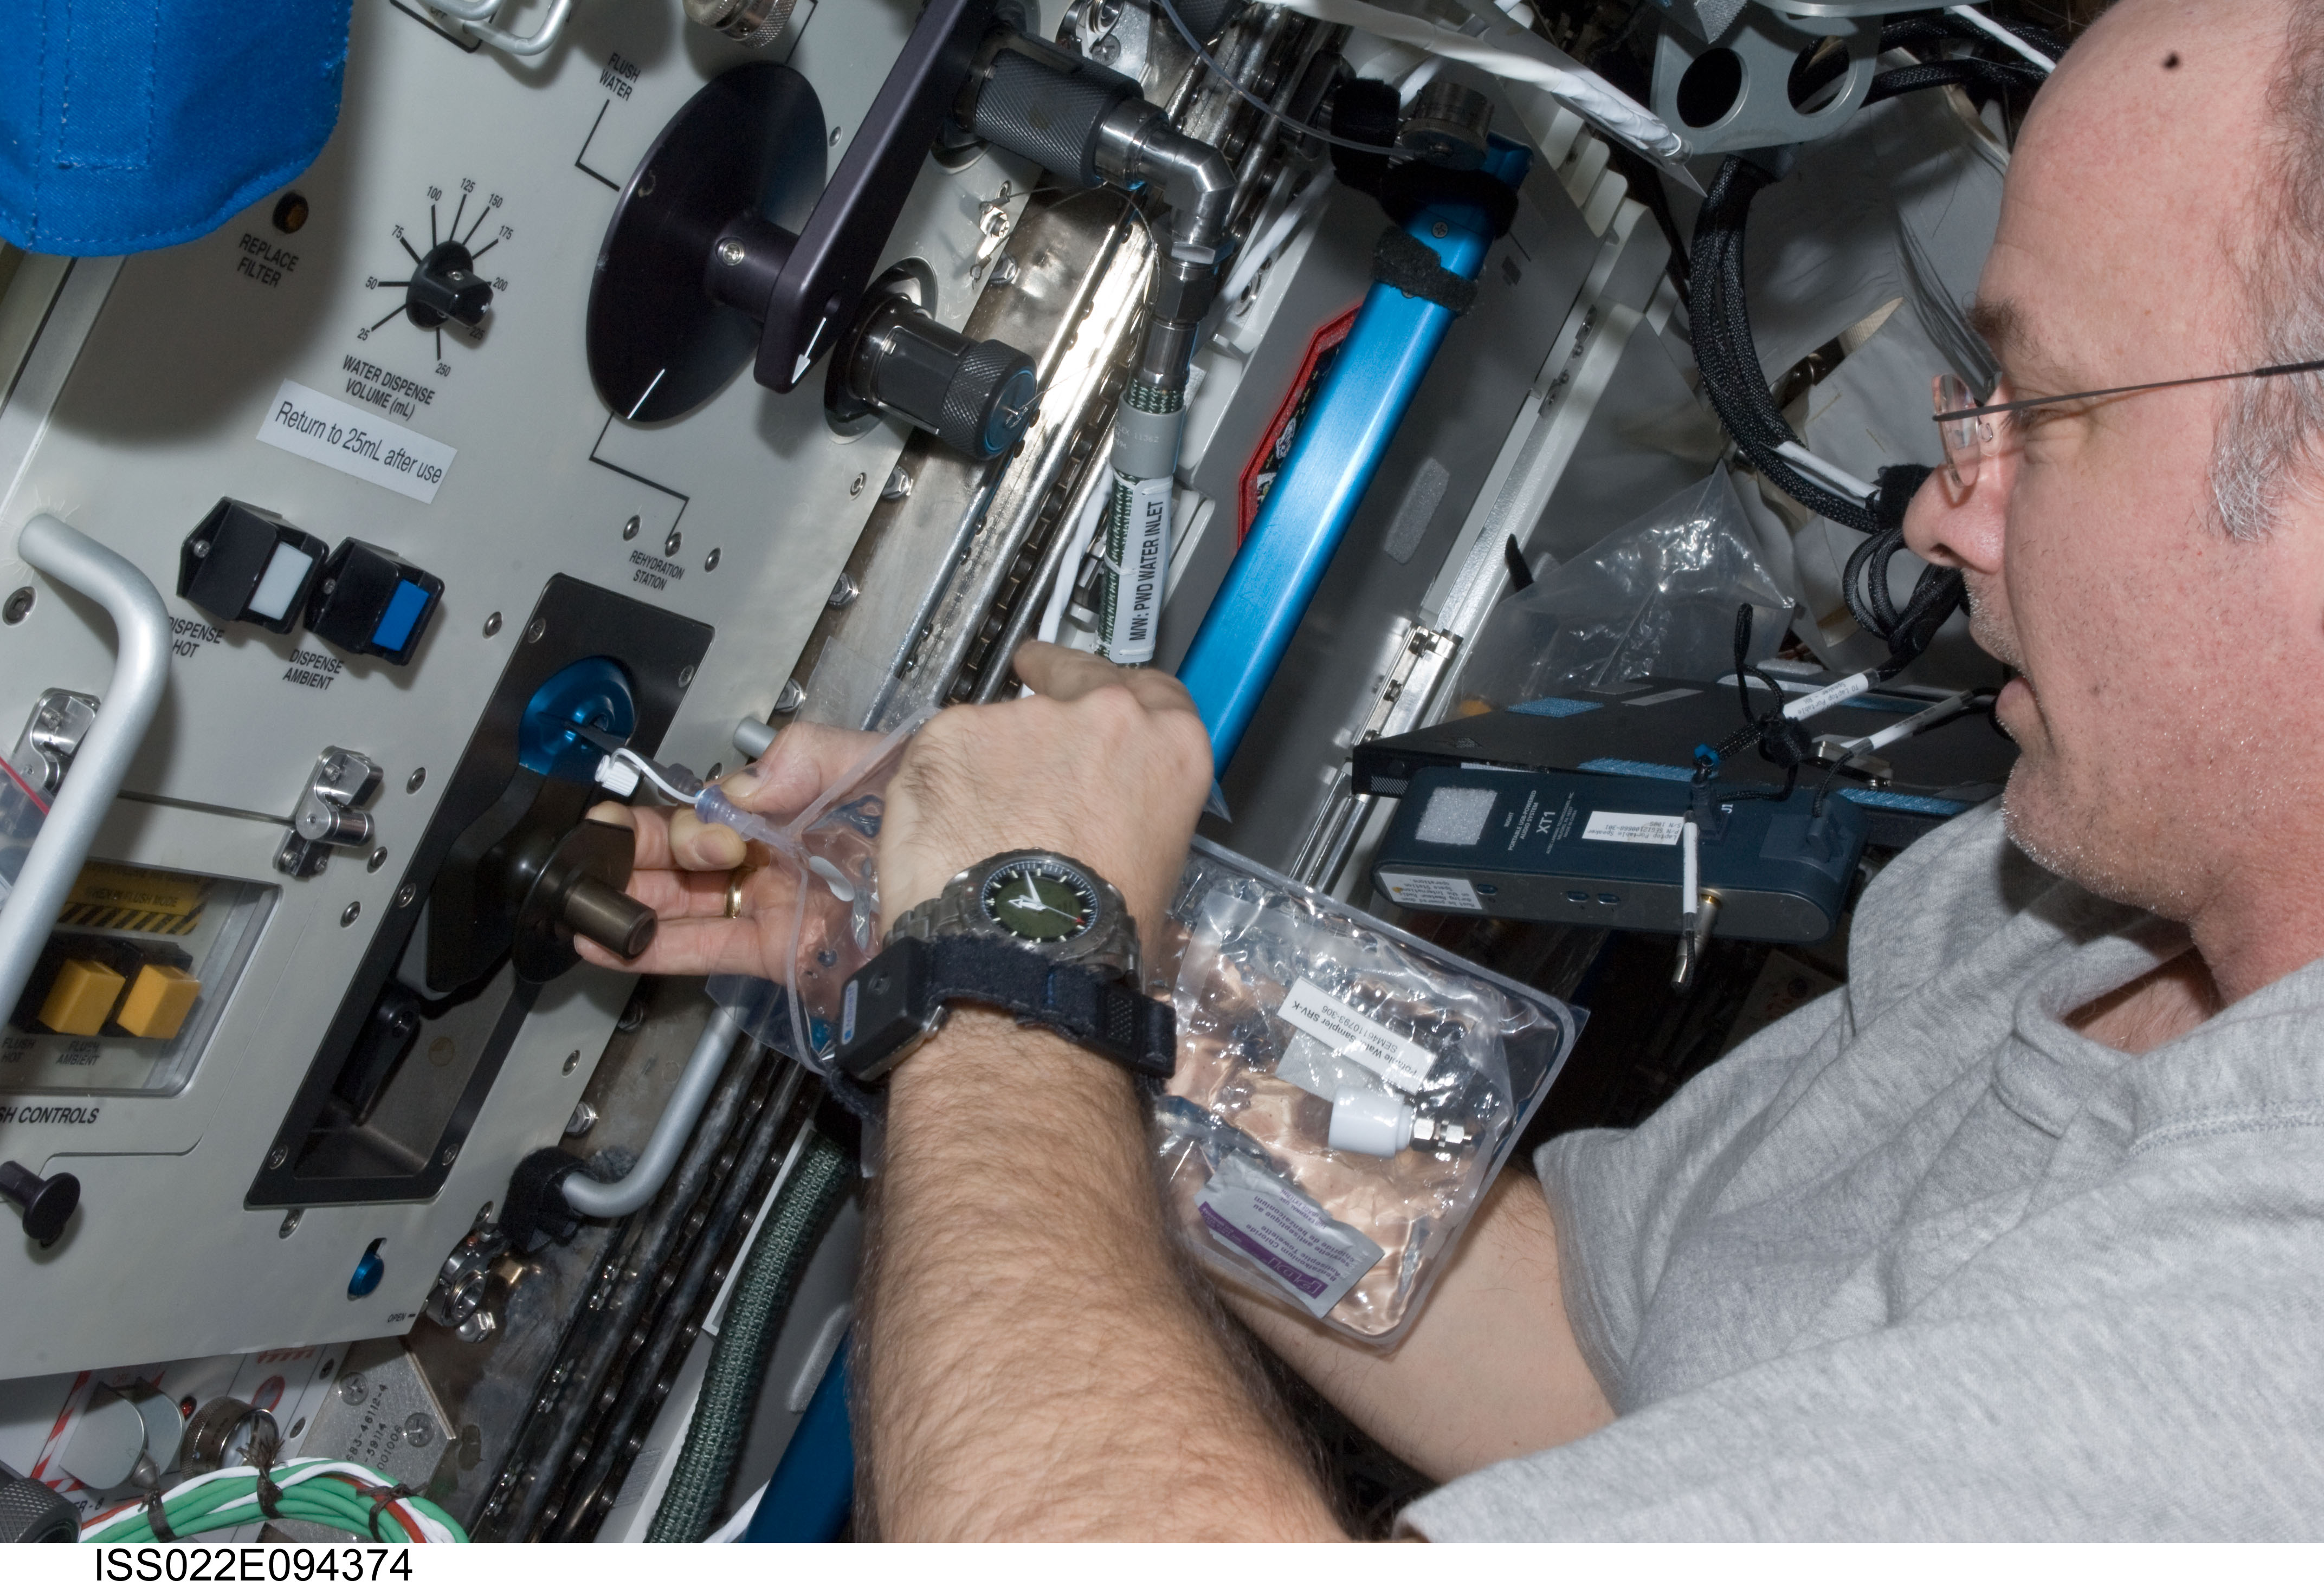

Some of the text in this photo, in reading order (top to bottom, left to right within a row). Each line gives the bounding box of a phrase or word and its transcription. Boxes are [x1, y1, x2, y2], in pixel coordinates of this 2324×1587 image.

[608, 52, 641, 83] FLUSH
[599, 69, 632, 101] WATER
[427, 186, 442, 201] 100
[460, 178, 475, 192] 125
[489, 193, 503, 208] 150
[391, 225, 404, 238] 75
[499, 225, 513, 239] 175
[239, 233, 299, 271] REPLACE
[237, 256, 281, 288] FILTER
[365, 276, 378, 289] 50
[493, 277, 508, 292] 200
[357, 328, 370, 341] 25
[470, 326, 485, 340] 225
[343, 355, 435, 405] WATER DISPENSE
[436, 363, 451, 377] 250
[346, 378, 415, 421] VOLUME (mL)
[275, 401, 442, 484] Return to 25mL after use
[1145, 501, 1163, 536] INLET
[629, 550, 685, 580] REHYDRATION
[1138, 538, 1159, 581] WATER
[633, 569, 667, 591] STATION
[1134, 584, 1153, 611] PWD
[173, 639, 199, 657] HOT
[289, 649, 344, 674] DISPENSE
[283, 668, 334, 690] AMBIENT
[1829, 688, 1849, 701] Laptop
[1798, 700, 1826, 714] Portable
[1504, 812, 1514, 827] RIGHT
[1508, 791, 1537, 851] PORTABLE USB-POWERED
[1520, 802, 1539, 839] AUDIO SYSTEM
[1536, 812, 1555, 833] XT1
[1618, 830, 1649, 838] Portable
[1292, 1000, 1320, 1022] SRV-K
[1321, 1005, 1398, 1053] SEM46110793-306
[1323, 1018, 1356, 1043] Sampler
[2, 1037, 36, 1049] FLUSH
[68, 1040, 100, 1052] FLUSH
[1360, 1039, 1382, 1059] Wat
[1, 1052, 23, 1063] HOT
[56, 1054, 100, 1065] AMBIENT
[18, 1107, 99, 1124] CONTROLS
[1253, 1203, 1264, 1213] au
[1280, 1197, 1290, 1206] USE
[1254, 1196, 1308, 1239] benzalconium
[1246, 1224, 1279, 1248] Chloride
[1266, 1212, 1313, 1247] antiseptique
[1309, 1235, 1320, 1243] de
[1261, 1226, 1340, 1277] Antiseptic Towelette
[1315, 1246, 1350, 1267] serviette
[1281, 1247, 1336, 1281] Benzalkonium
[1268, 1257, 1322, 1294] PDI
[388, 1313, 407, 1323] OPEN
[74, 1498, 105, 1513] R-8
